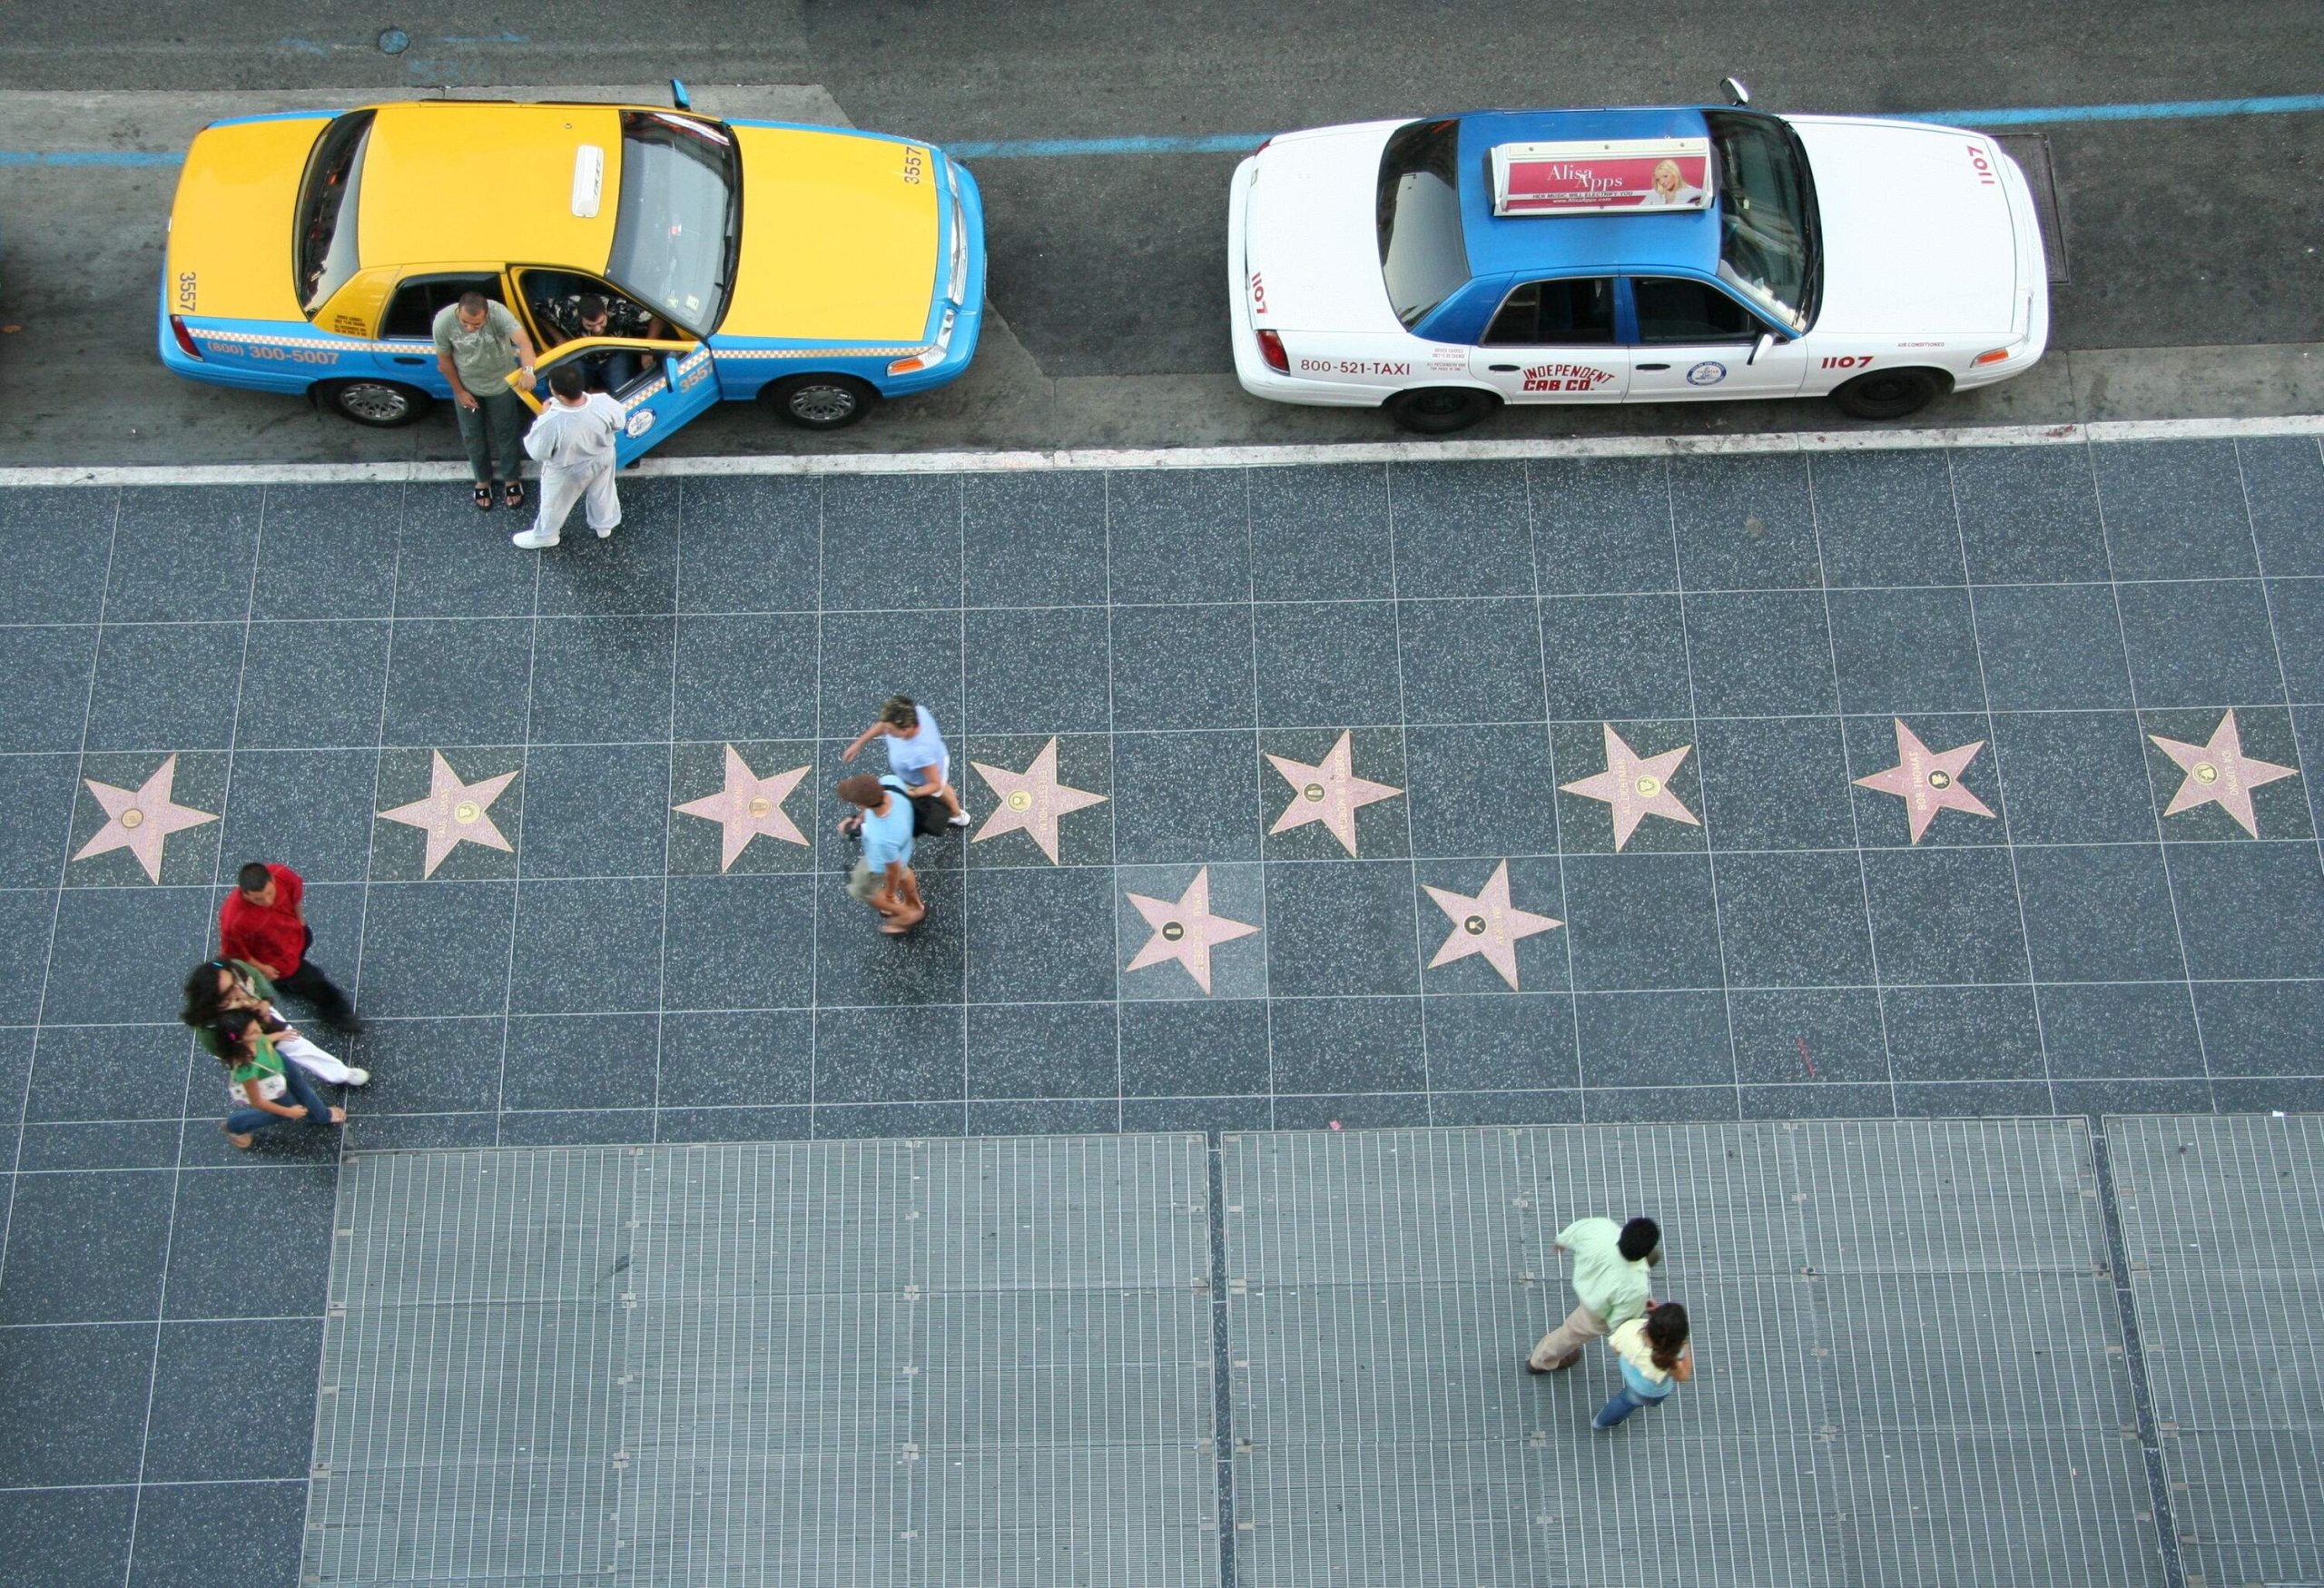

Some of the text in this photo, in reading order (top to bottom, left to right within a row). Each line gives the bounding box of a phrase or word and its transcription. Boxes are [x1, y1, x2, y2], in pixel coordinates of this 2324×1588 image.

[903, 147, 922, 185] 3557
[1546, 164, 1592, 181] Alisa
[1966, 145, 1995, 185] 1107
[1575, 175, 1623, 192] Apps
[180, 271, 197, 312] 3557
[1251, 272, 1269, 316] 1107
[207, 341, 340, 365] (800) 300-5007
[1300, 359, 1410, 376] 800-521-TAXI
[1821, 355, 1874, 370] 1107
[679, 360, 714, 394] 3557
[1523, 363, 1615, 386] INDEPENDENT
[1523, 380, 1562, 391] CAB
[1335, 750, 1345, 784] ROBERT
[1909, 751, 1926, 810] BOB THOMAS
[2225, 766, 2239, 795] LUPINO
[1337, 799, 1349, 837] MORGAN
[1192, 893, 1202, 917] RYAN
